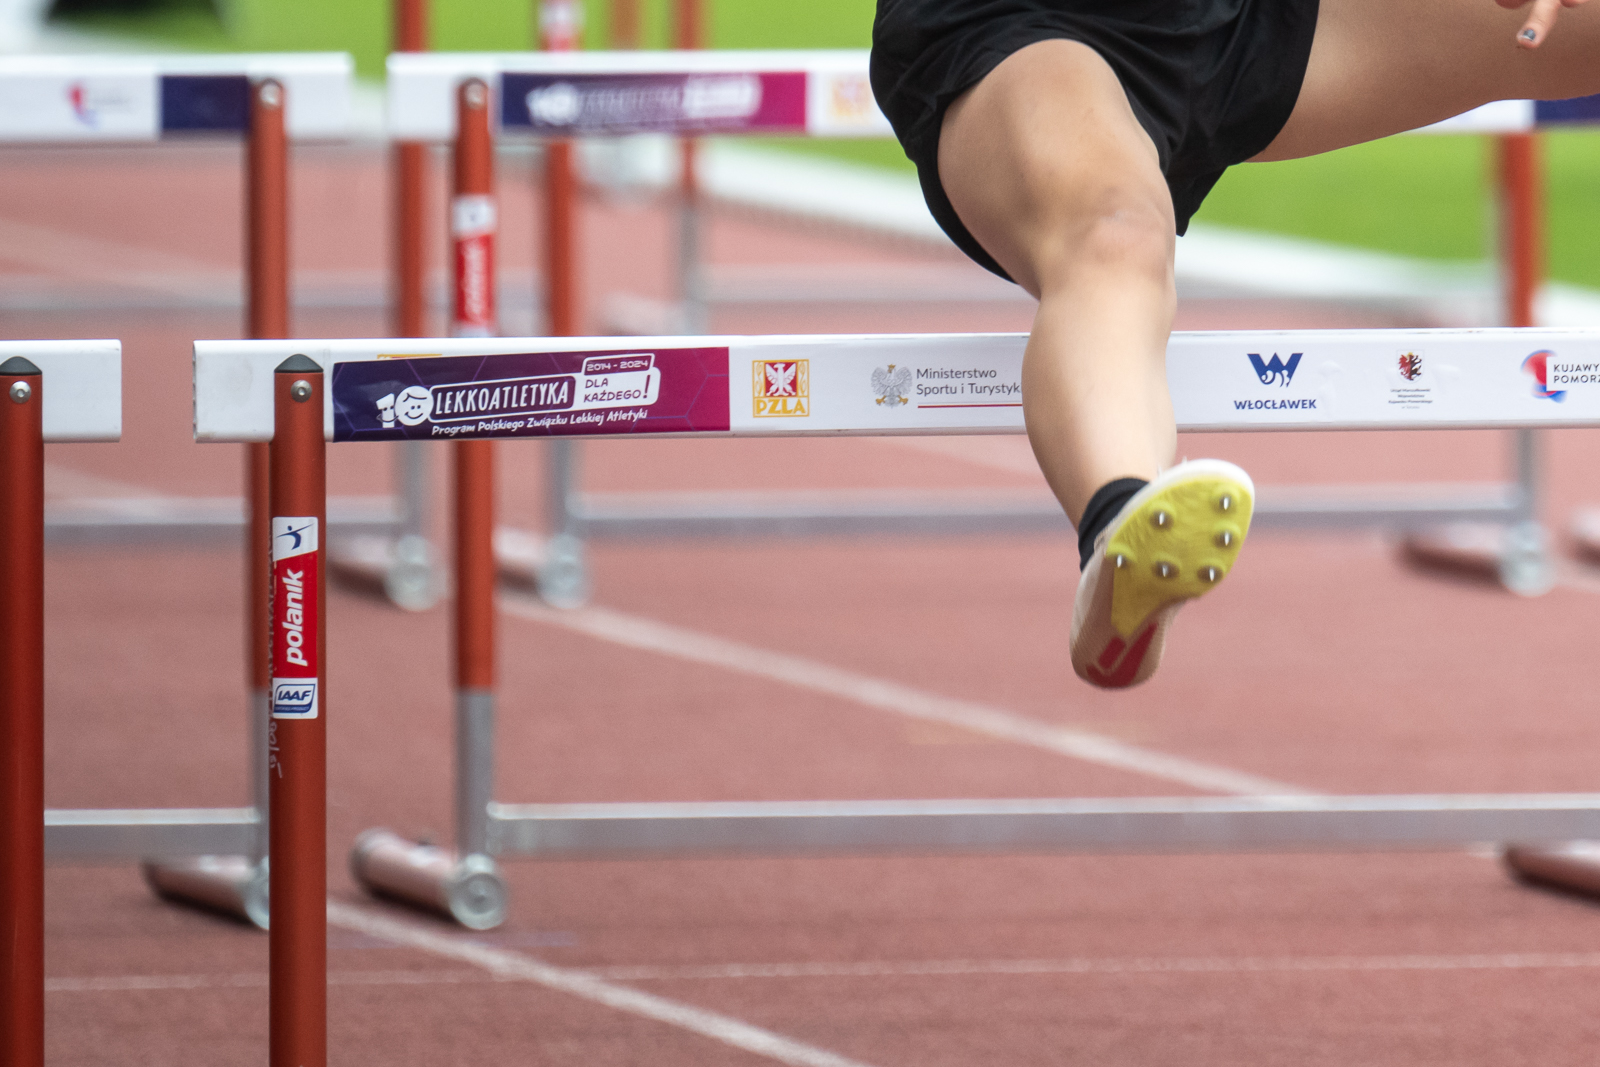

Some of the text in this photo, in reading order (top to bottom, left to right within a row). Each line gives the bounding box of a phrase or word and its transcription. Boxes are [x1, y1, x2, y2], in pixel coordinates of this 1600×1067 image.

[586, 361, 611, 372] 2014
[619, 359, 649, 370] 2024
[1553, 363, 1600, 373] KUJAWY
[916, 367, 998, 380] Ministerstwo
[583, 374, 651, 403] KAŻDEGO!
[585, 378, 609, 389] DLA
[916, 383, 958, 396] Sportu
[967, 382, 1021, 396] Turystyk
[435, 381, 569, 415] LEKKOATLETYKA
[1233, 399, 1317, 410] WŁOCŁAWEK
[756, 398, 806, 415] PZLA
[432, 409, 648, 436] Program Polskiego Związku Lekkiej Atletyki
[282, 569, 309, 667] polanik
[278, 690, 312, 701] IAAF
